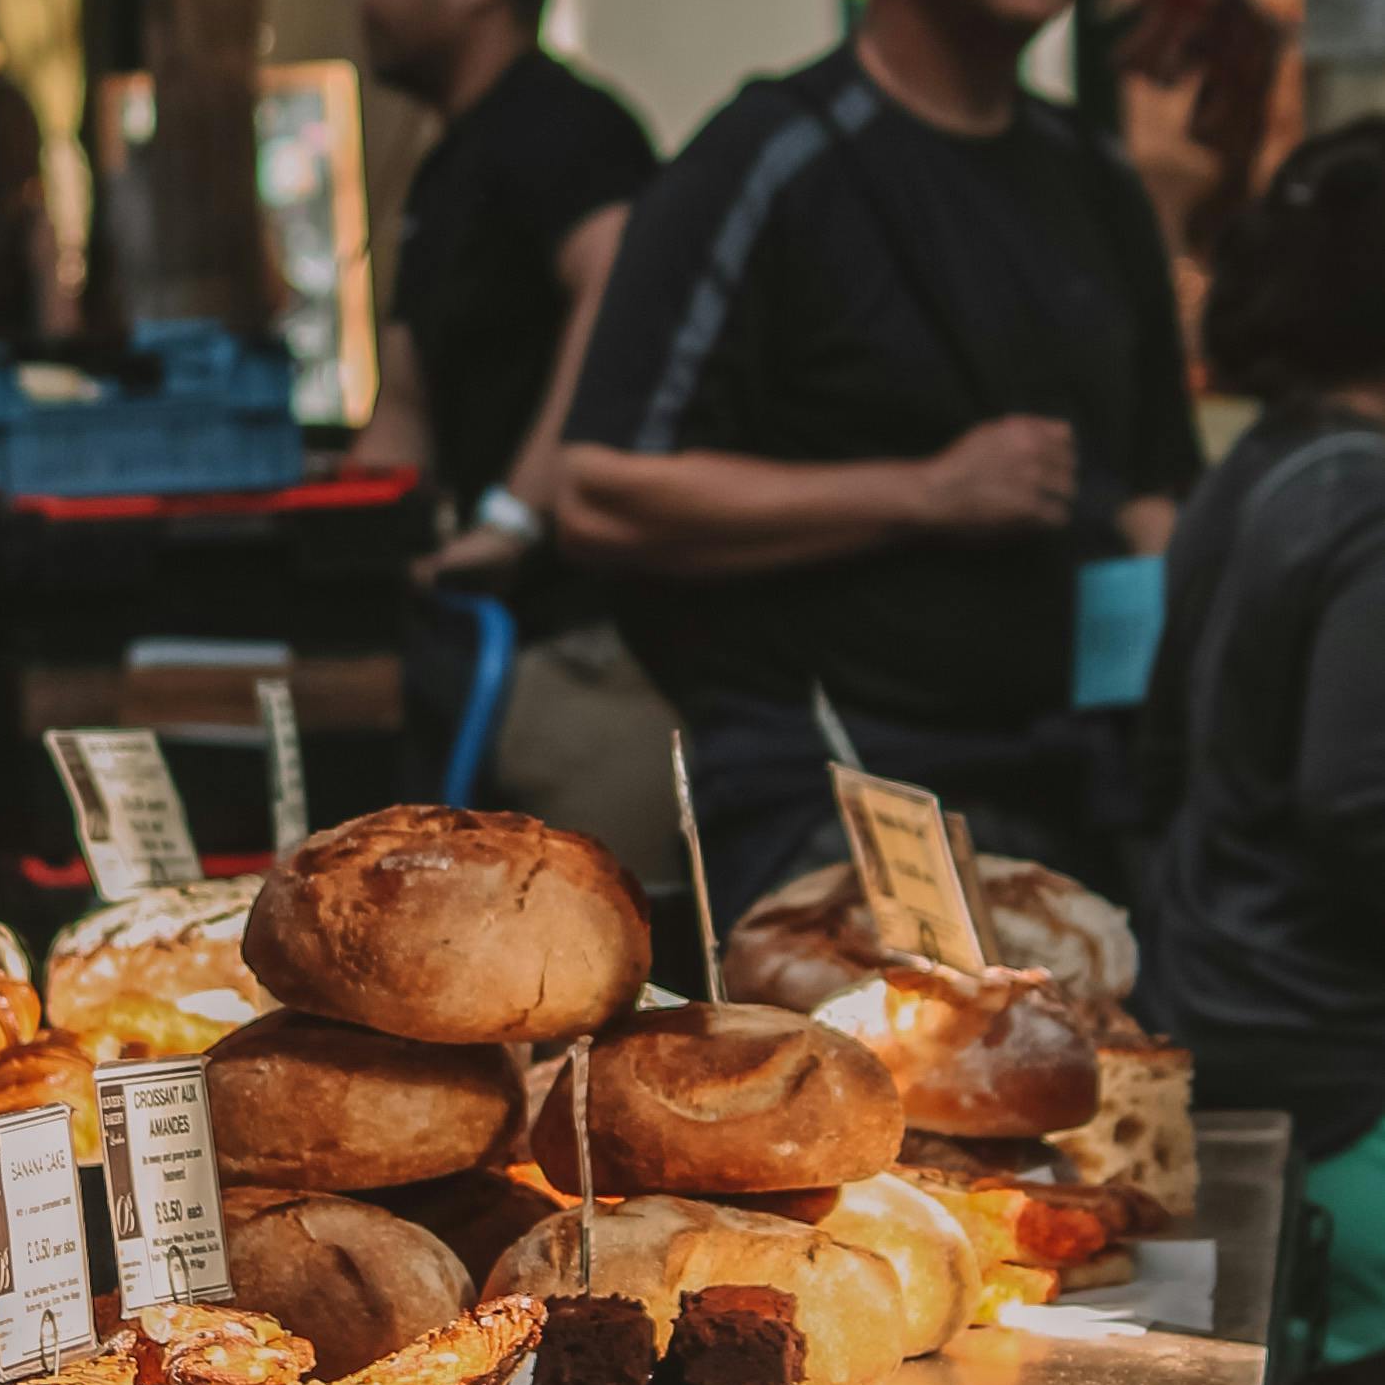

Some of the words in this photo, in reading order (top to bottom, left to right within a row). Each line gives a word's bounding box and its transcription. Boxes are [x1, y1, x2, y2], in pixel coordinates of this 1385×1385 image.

[134, 1086, 179, 1109] CROISSANT
[181, 1083, 198, 1103] AUX
[150, 1114, 191, 1136] AMANDES
